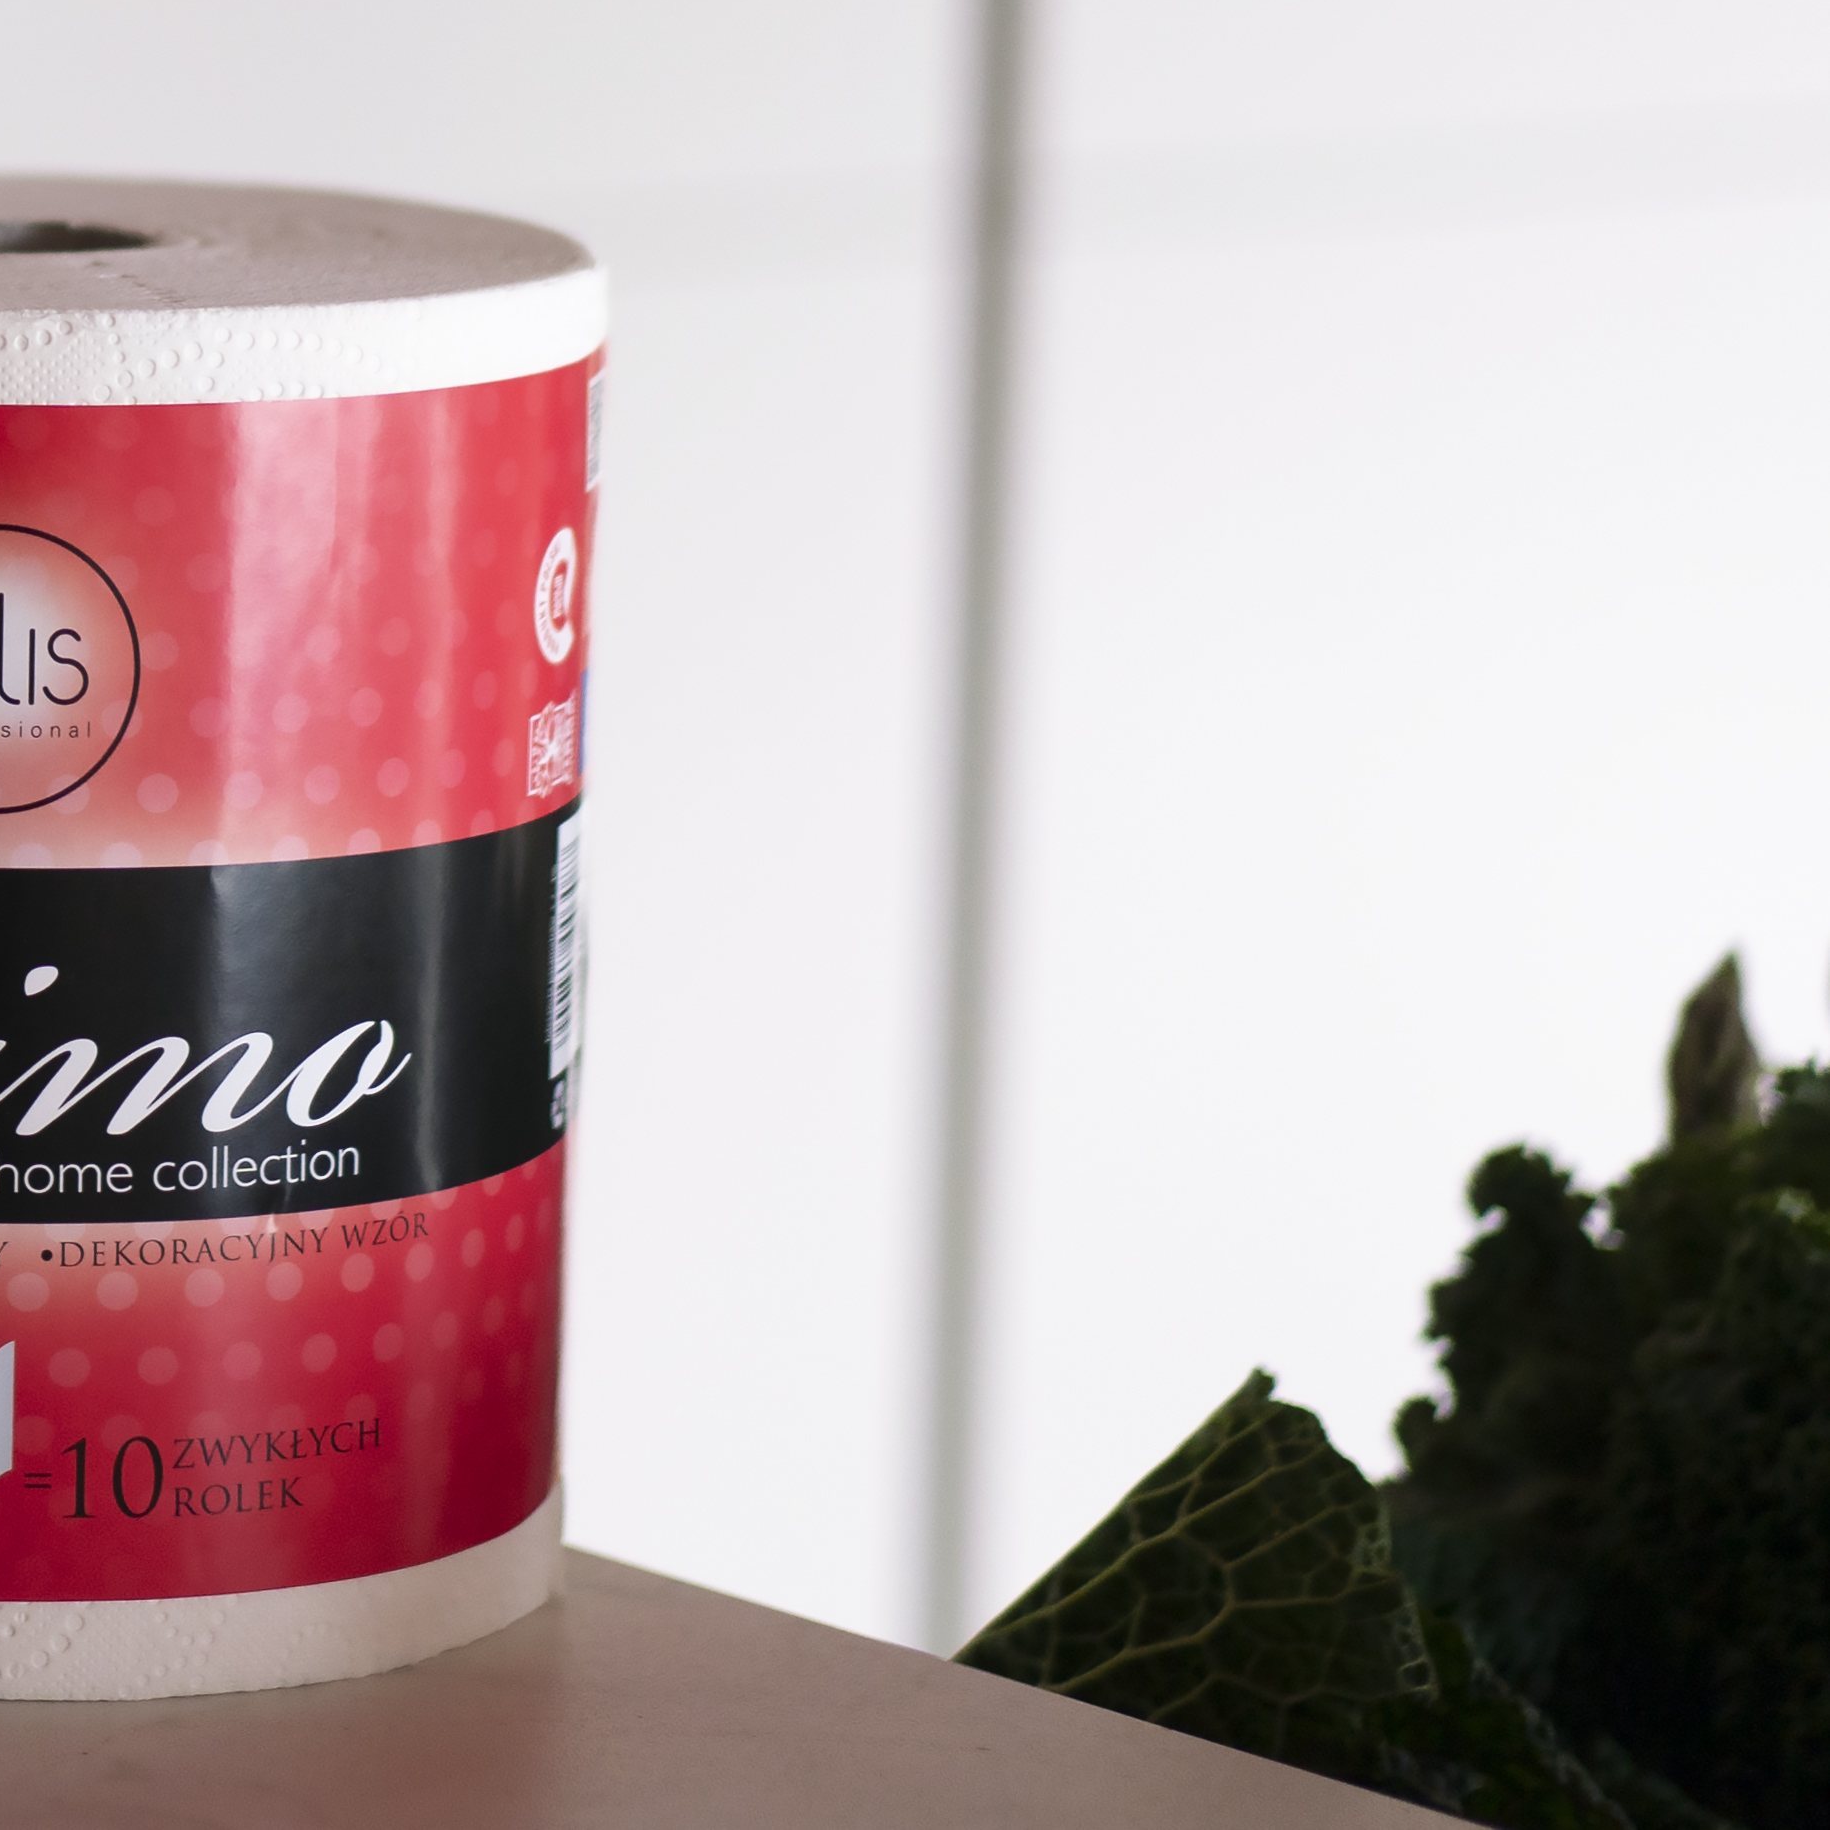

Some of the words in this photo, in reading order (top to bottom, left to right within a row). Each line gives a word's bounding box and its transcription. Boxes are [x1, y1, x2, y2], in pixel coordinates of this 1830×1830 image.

[152, 1138, 361, 1193] collection
[59, 1226, 329, 1267] DEKORACYJNY
[341, 1210, 430, 1250] WZÓR
[172, 1417, 382, 1469] ZWYKŁYCH
[172, 1476, 305, 1518] ROLEK
